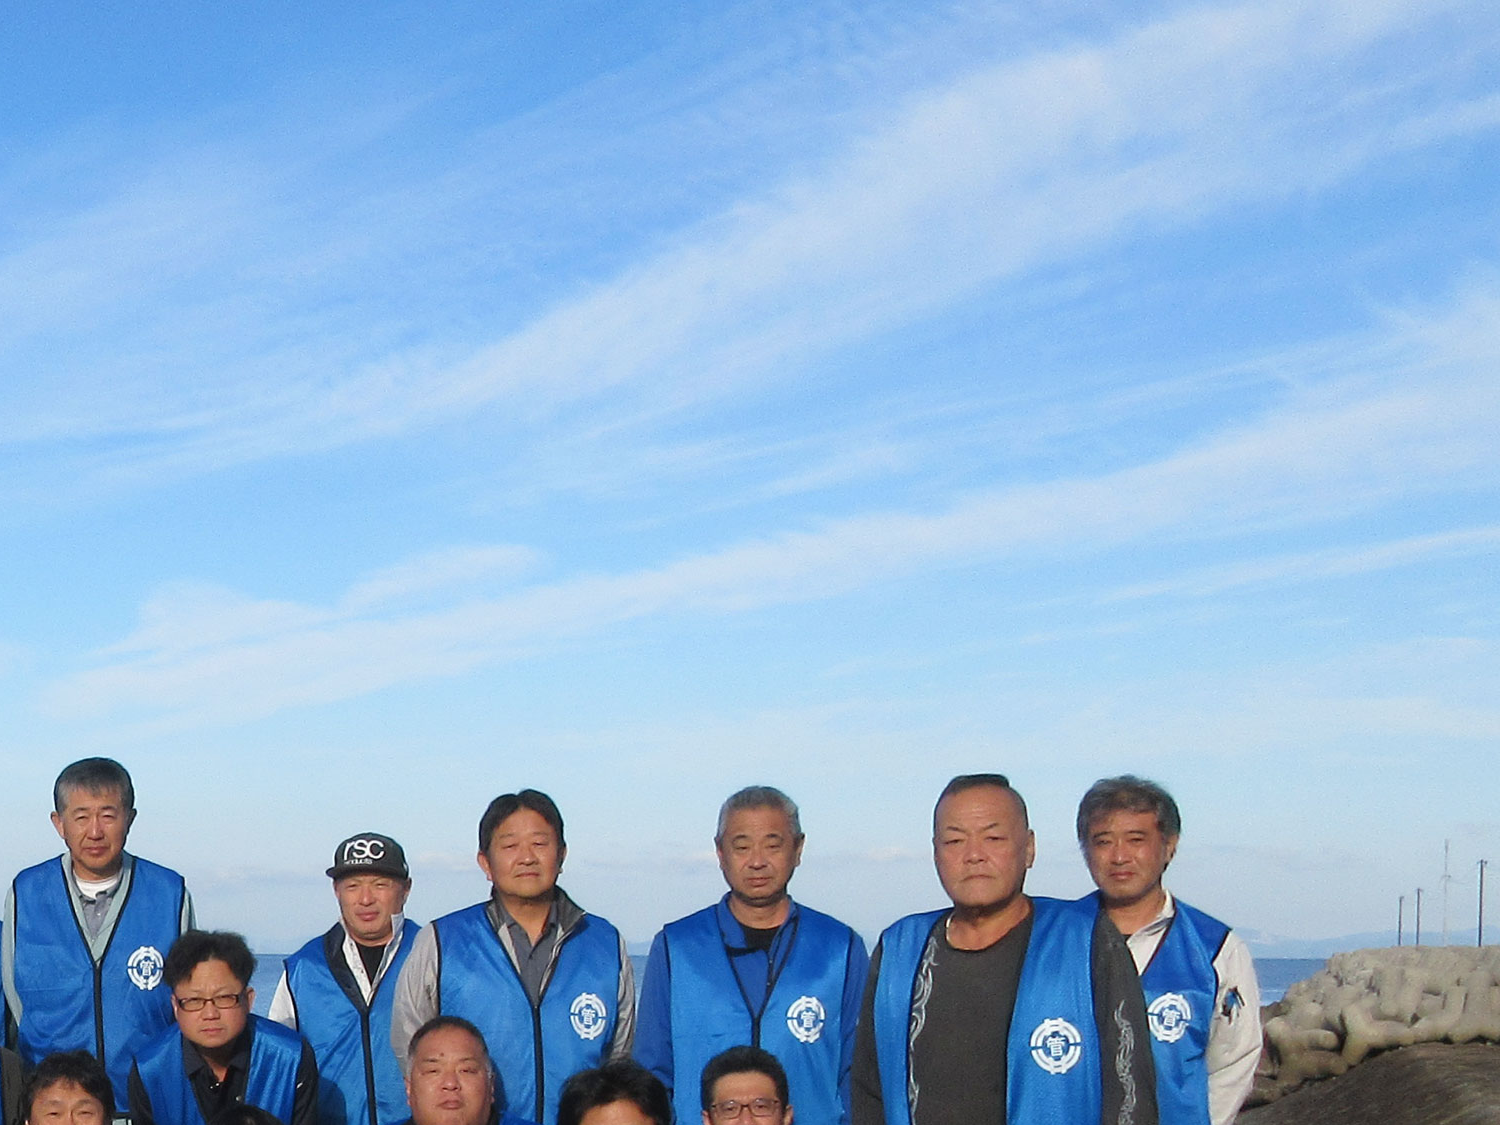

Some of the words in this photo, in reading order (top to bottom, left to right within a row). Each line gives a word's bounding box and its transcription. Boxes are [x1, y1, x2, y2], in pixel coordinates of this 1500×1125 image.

[344, 839, 385, 861] rsc
[1162, 1008, 1180, 1027] 管
[1045, 1036, 1066, 1057] 管
